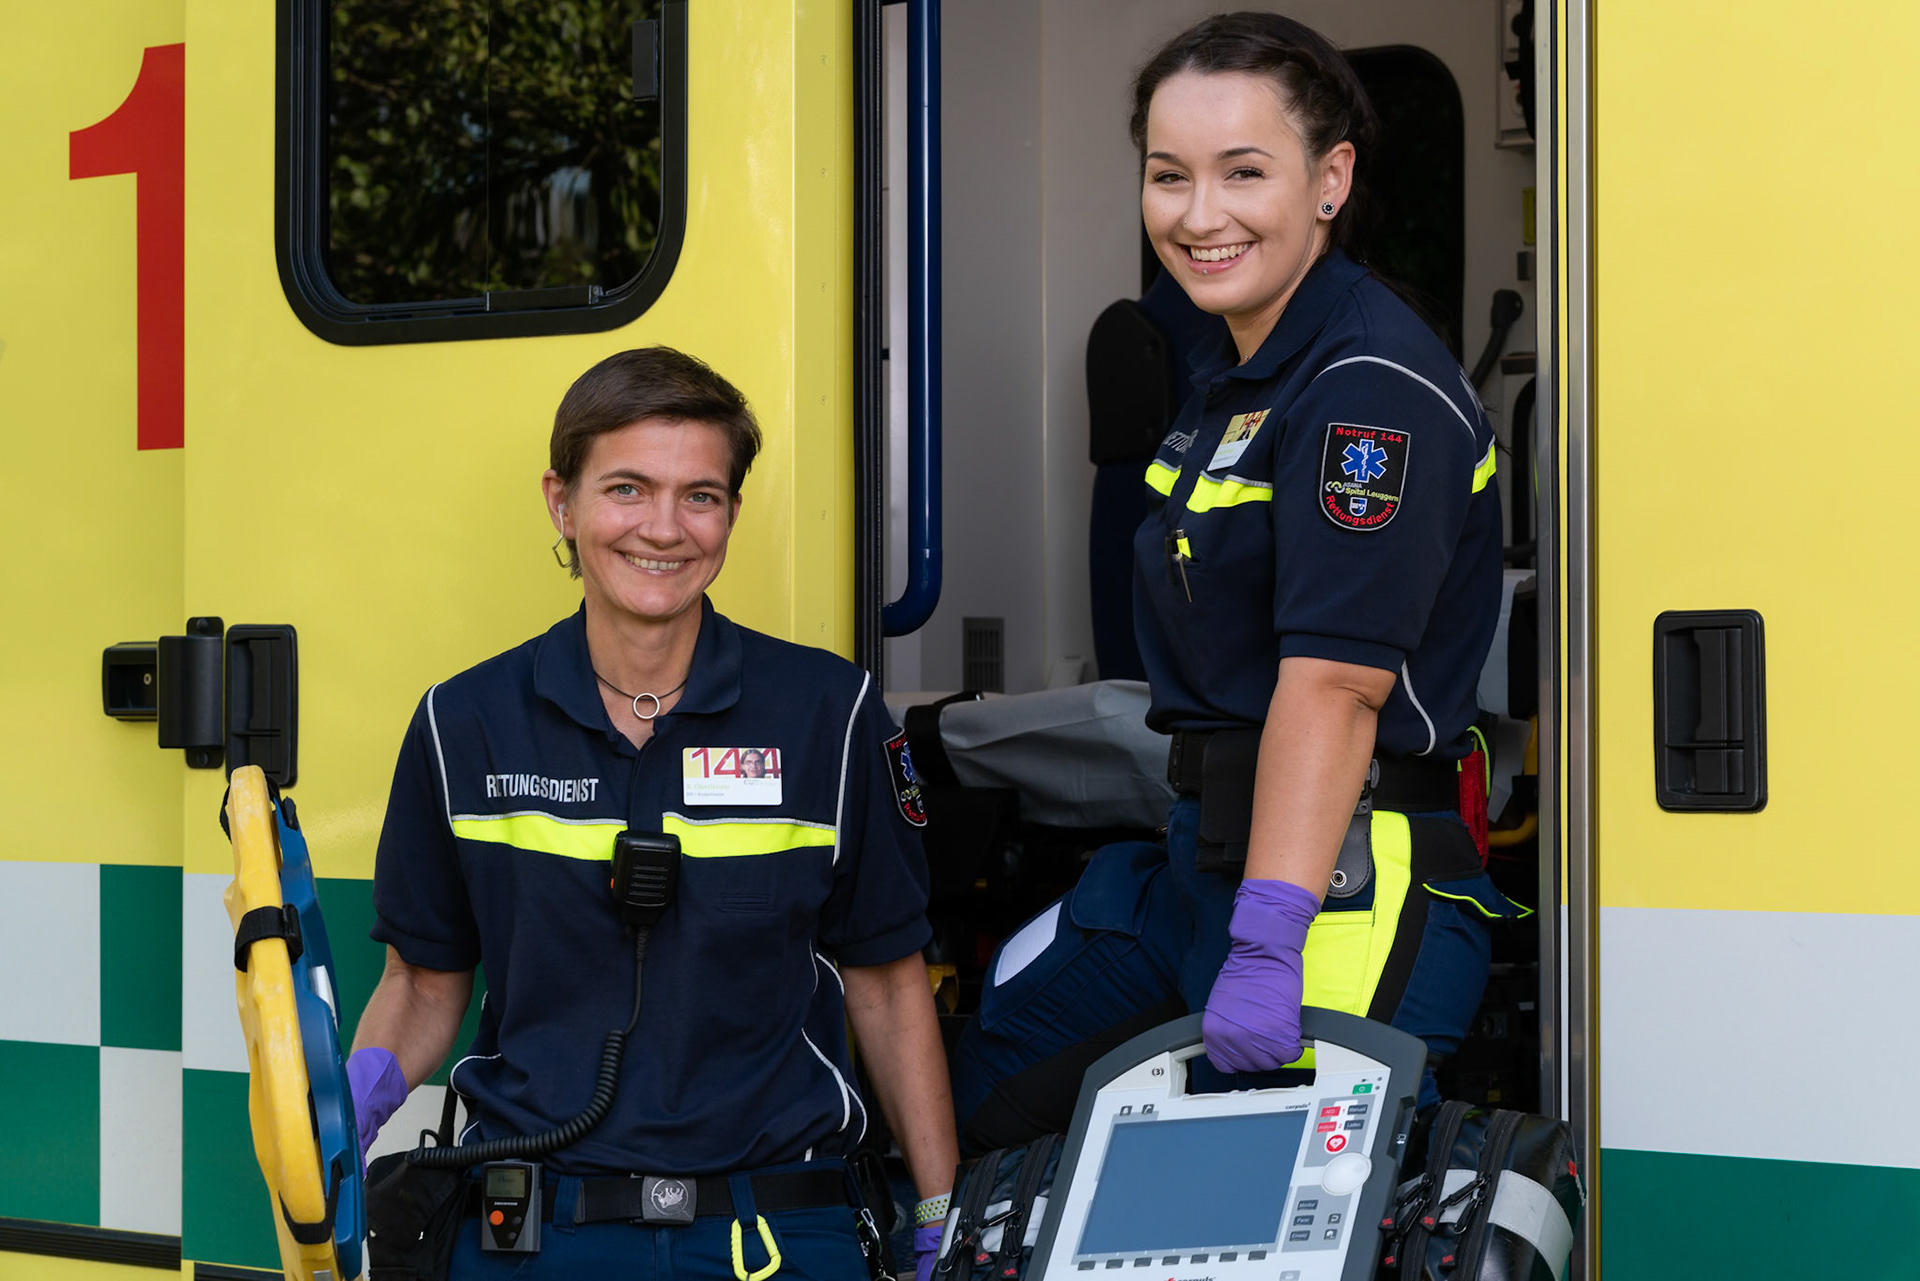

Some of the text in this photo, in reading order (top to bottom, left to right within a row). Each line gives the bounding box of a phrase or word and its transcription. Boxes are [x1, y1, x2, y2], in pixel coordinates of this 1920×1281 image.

[69, 42, 185, 451] 1
[1336, 427, 1403, 444] Notruf 144
[1345, 487, 1399, 502] Spital Leuggern
[1325, 495, 1395, 527] Rettungsdienst
